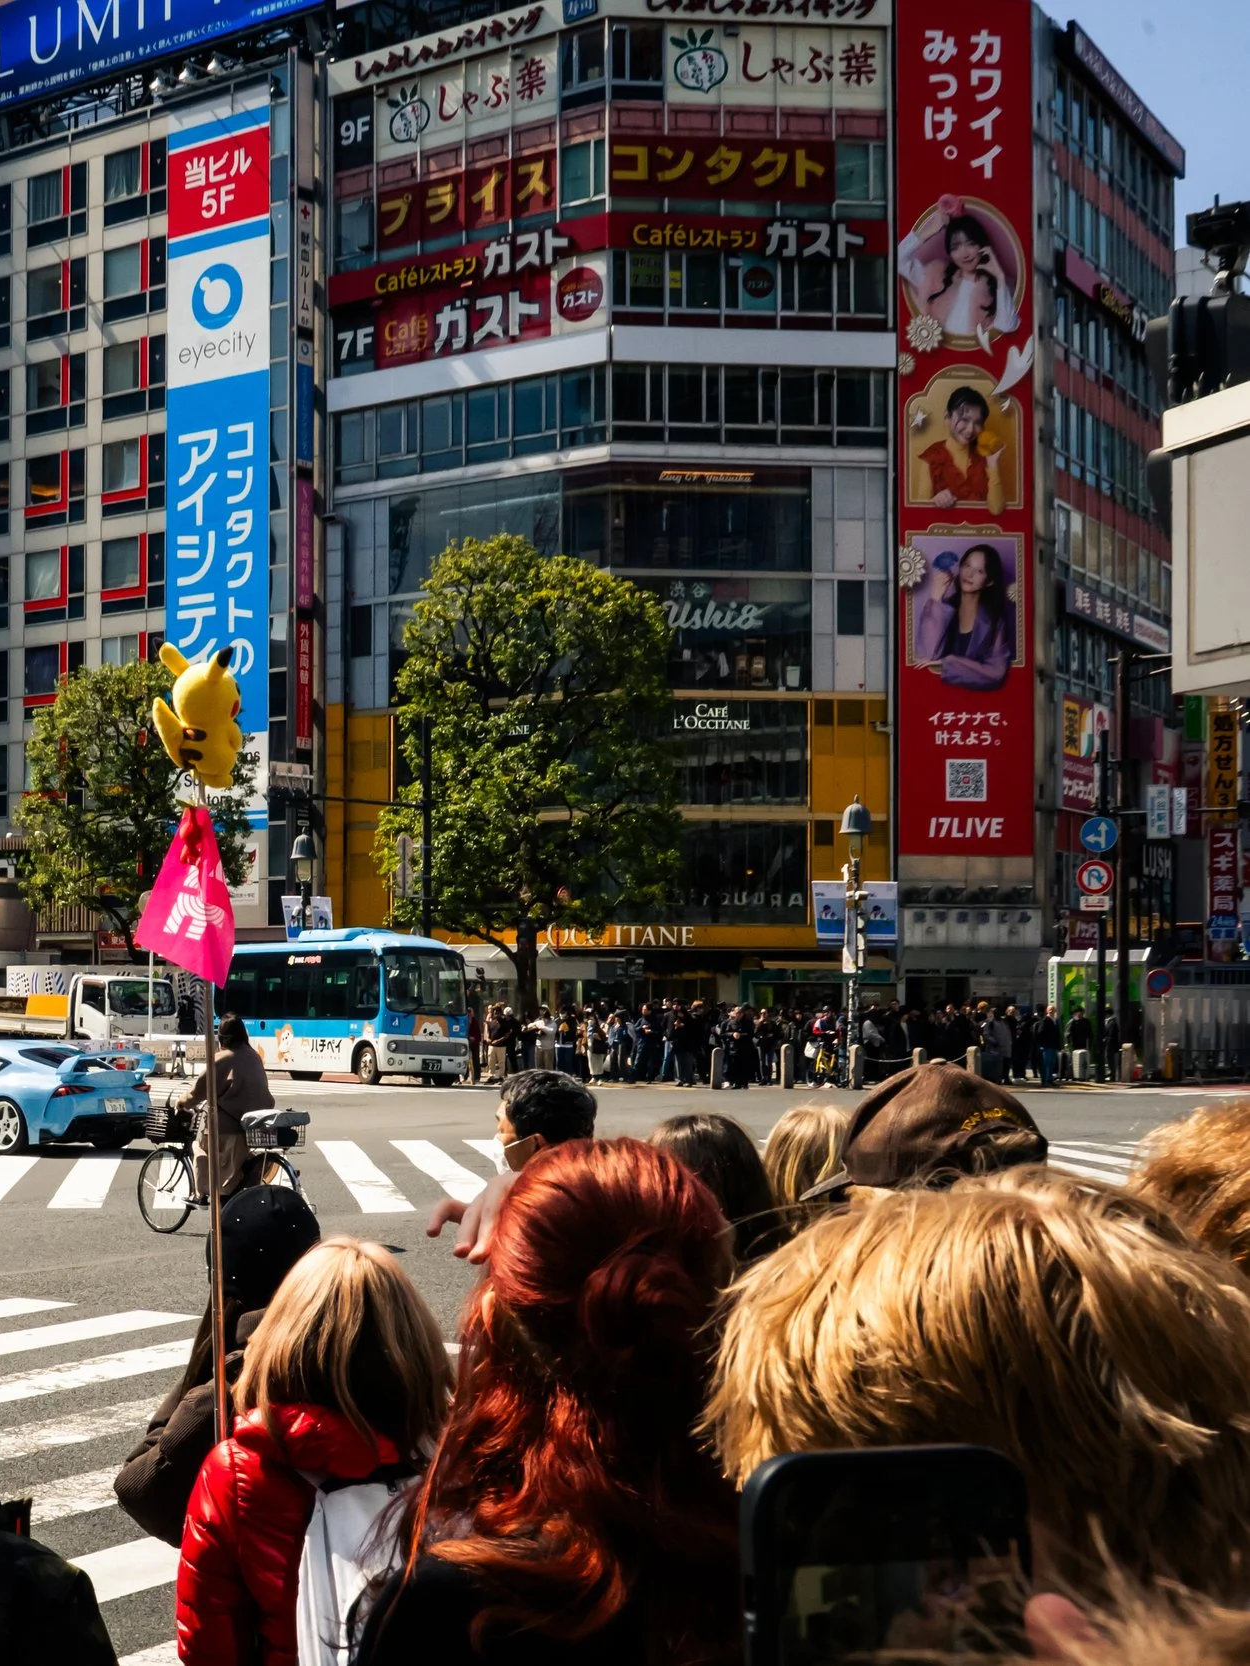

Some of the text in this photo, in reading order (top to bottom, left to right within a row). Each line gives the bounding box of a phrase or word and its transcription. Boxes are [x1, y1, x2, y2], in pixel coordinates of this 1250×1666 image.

[742, 41, 877, 87] しゃぶ葉
[438, 58, 547, 122] しゃぶ葉
[969, 29, 1003, 180] カワイイ
[340, 116, 371, 146] 9F
[184, 147, 253, 190] 当ビル
[612, 145, 826, 188] コンタクト
[200, 183, 236, 219] 5F
[379, 158, 552, 236] プライス
[482, 228, 569, 280] ガスト
[764, 219, 866, 259] ガスト
[562, 290, 599, 310] ガスト
[384, 314, 430, 342] Café
[434, 291, 540, 354] ガスト
[178, 329, 257, 367] eyecity
[337, 326, 375, 361] 7F
[176, 428, 219, 666] アイシティ
[226, 421, 255, 676] コンタクトの
[694, 703, 729, 718] CAFÉ
[927, 711, 1010, 727] イチナナで、
[934, 730, 1002, 747] 叶えよう。
[928, 817, 1005, 838] 17LIVE
[1142, 844, 1172, 880] LUSH
[1212, 832, 1235, 911] スギ薬局
